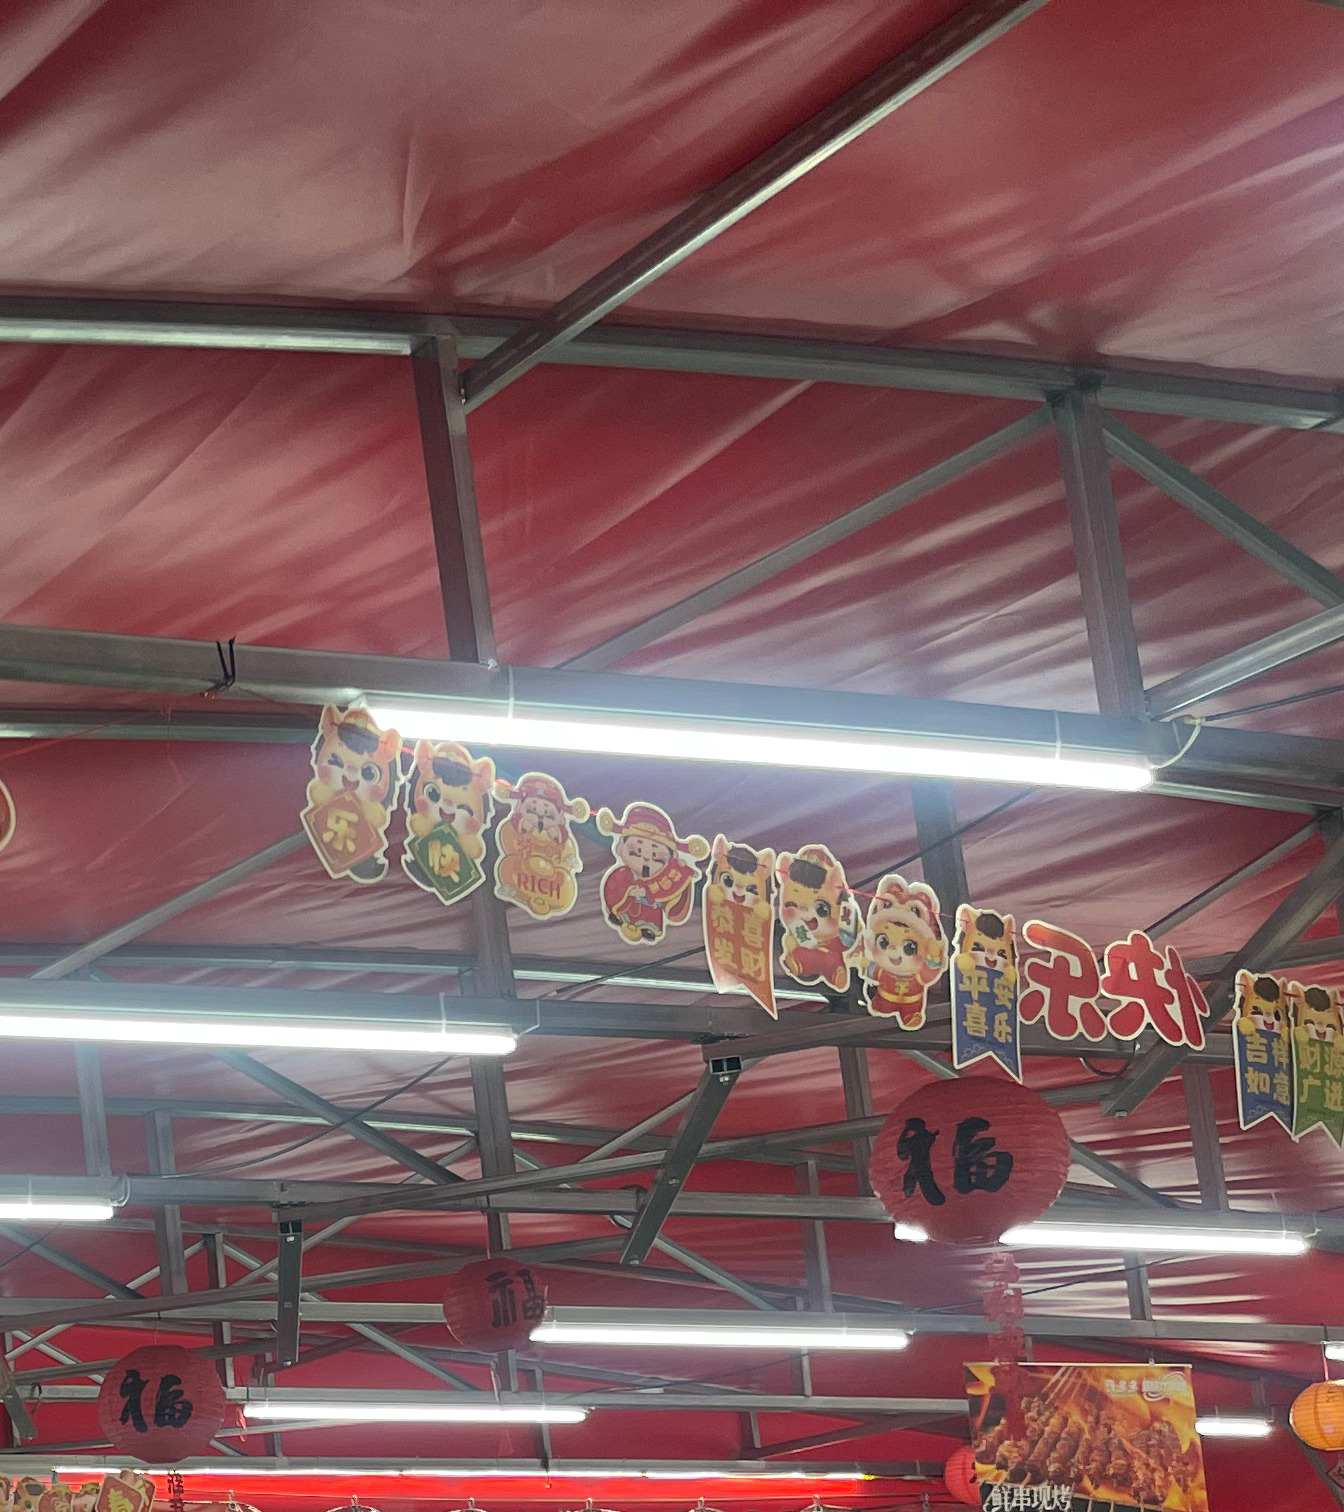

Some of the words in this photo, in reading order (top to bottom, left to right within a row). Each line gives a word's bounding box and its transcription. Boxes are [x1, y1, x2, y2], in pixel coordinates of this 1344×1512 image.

[517, 873, 561, 900] RICH
[1246, 1034, 1290, 1070] 吉祥
[1246, 1069, 1291, 1106] 如意
[898, 1118, 1013, 1205] 福
[120, 1369, 193, 1433] 福
[983, 1484, 1073, 1512] 鲜串现烤
